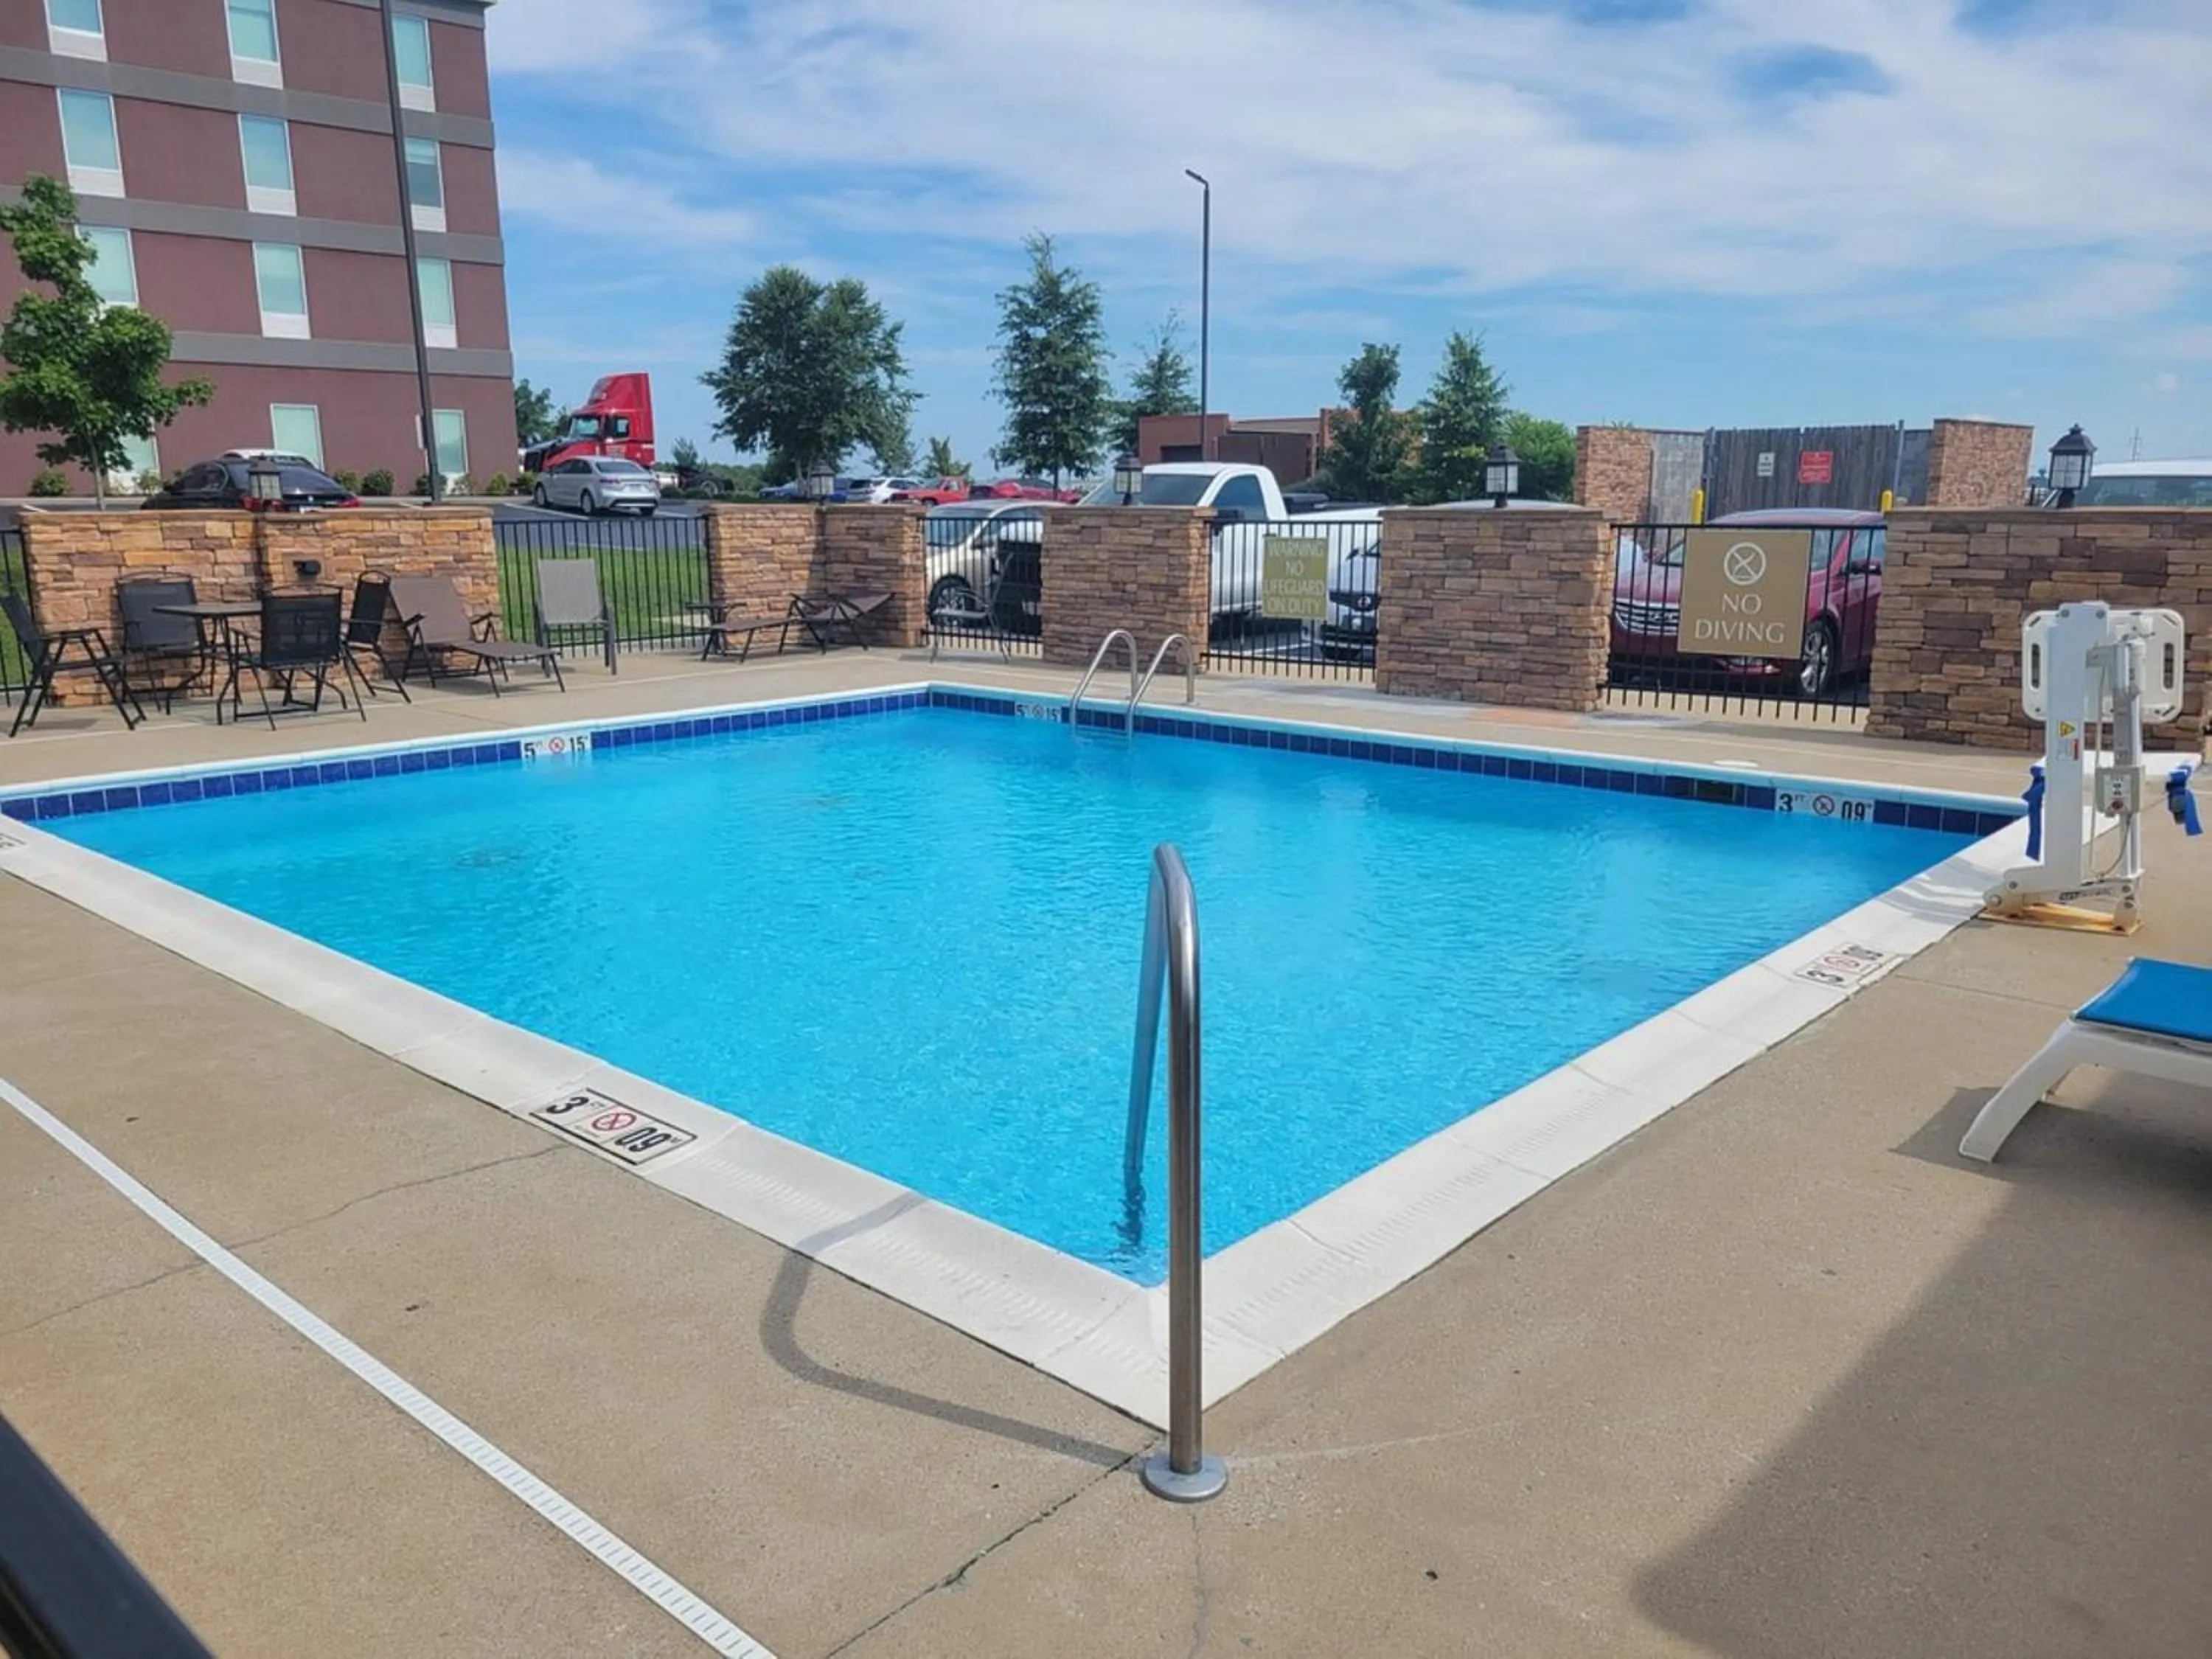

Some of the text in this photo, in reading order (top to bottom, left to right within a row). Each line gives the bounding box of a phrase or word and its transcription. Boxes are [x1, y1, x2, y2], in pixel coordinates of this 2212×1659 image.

[1268, 541, 1324, 557] WARNING
[1284, 559, 1304, 577] NO
[1264, 578, 1324, 596] LIFEGUARD
[1267, 597, 1321, 615] ON DUTY
[1722, 593, 1762, 615] NO
[1694, 618, 1784, 644] DIVING
[524, 742, 536, 759] 5
[1778, 793, 1793, 812] 3
[546, 1096, 589, 1115] 3
